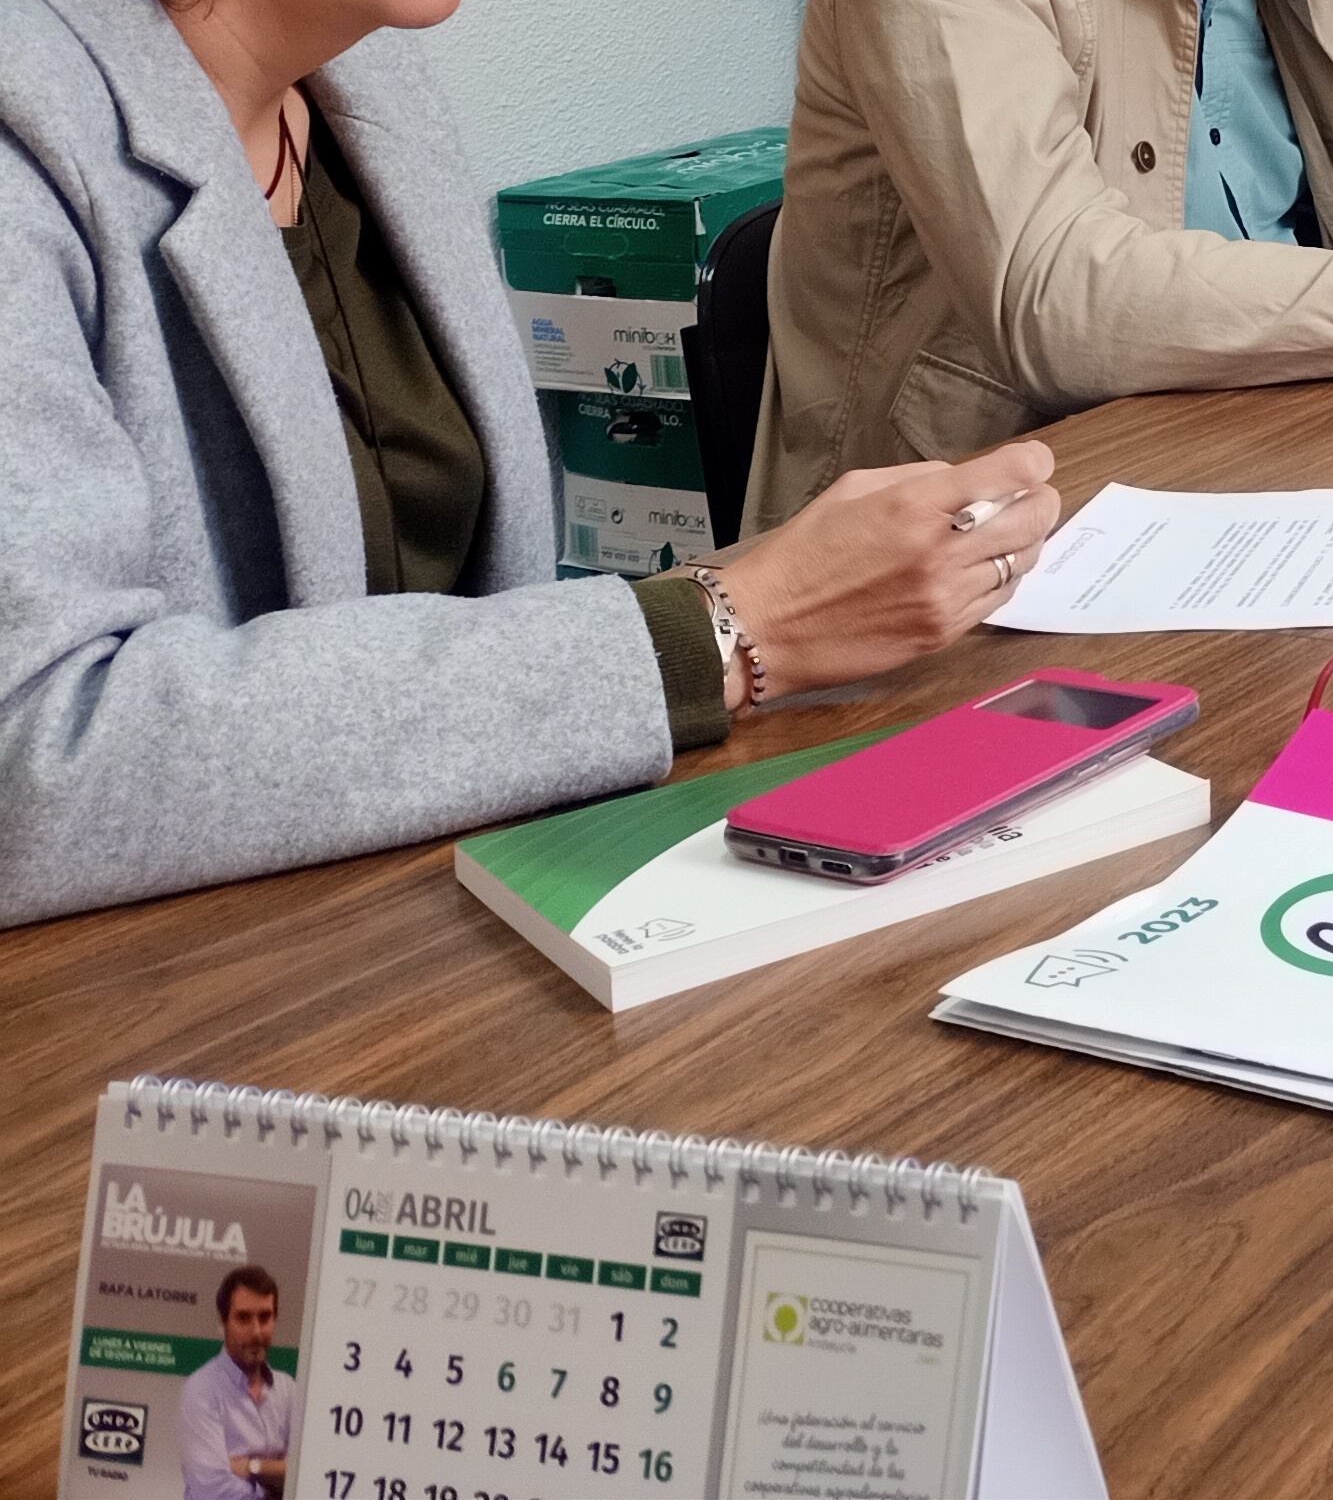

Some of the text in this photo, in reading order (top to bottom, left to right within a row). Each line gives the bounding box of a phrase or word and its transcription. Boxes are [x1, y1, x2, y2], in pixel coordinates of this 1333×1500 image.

[543, 213, 660, 231] CIERRA EL CÍRCULO.
[614, 326, 677, 345] minibox
[1117, 896, 1219, 945] 2023
[105, 1181, 148, 1213] LA
[345, 1187, 376, 1221] 04
[396, 1191, 497, 1236] ABRIL
[102, 1206, 248, 1253] BRÚJULA
[404, 1243, 429, 1258] mar
[507, 1255, 529, 1272] jue
[98, 1281, 198, 1306] RAFA LATORRE
[343, 1276, 679, 1348] 27 28 29 30 31 1 2
[809, 1297, 912, 1326] cooperativas
[809, 1316, 944, 1349] agro-alimentarias
[343, 1341, 673, 1414] 3 4 5 6 7 8 9
[329, 1404, 674, 1483] 10 11 12 13 14 15 16
[324, 1469, 356, 1500] 17
[373, 1477, 407, 1500] 18
